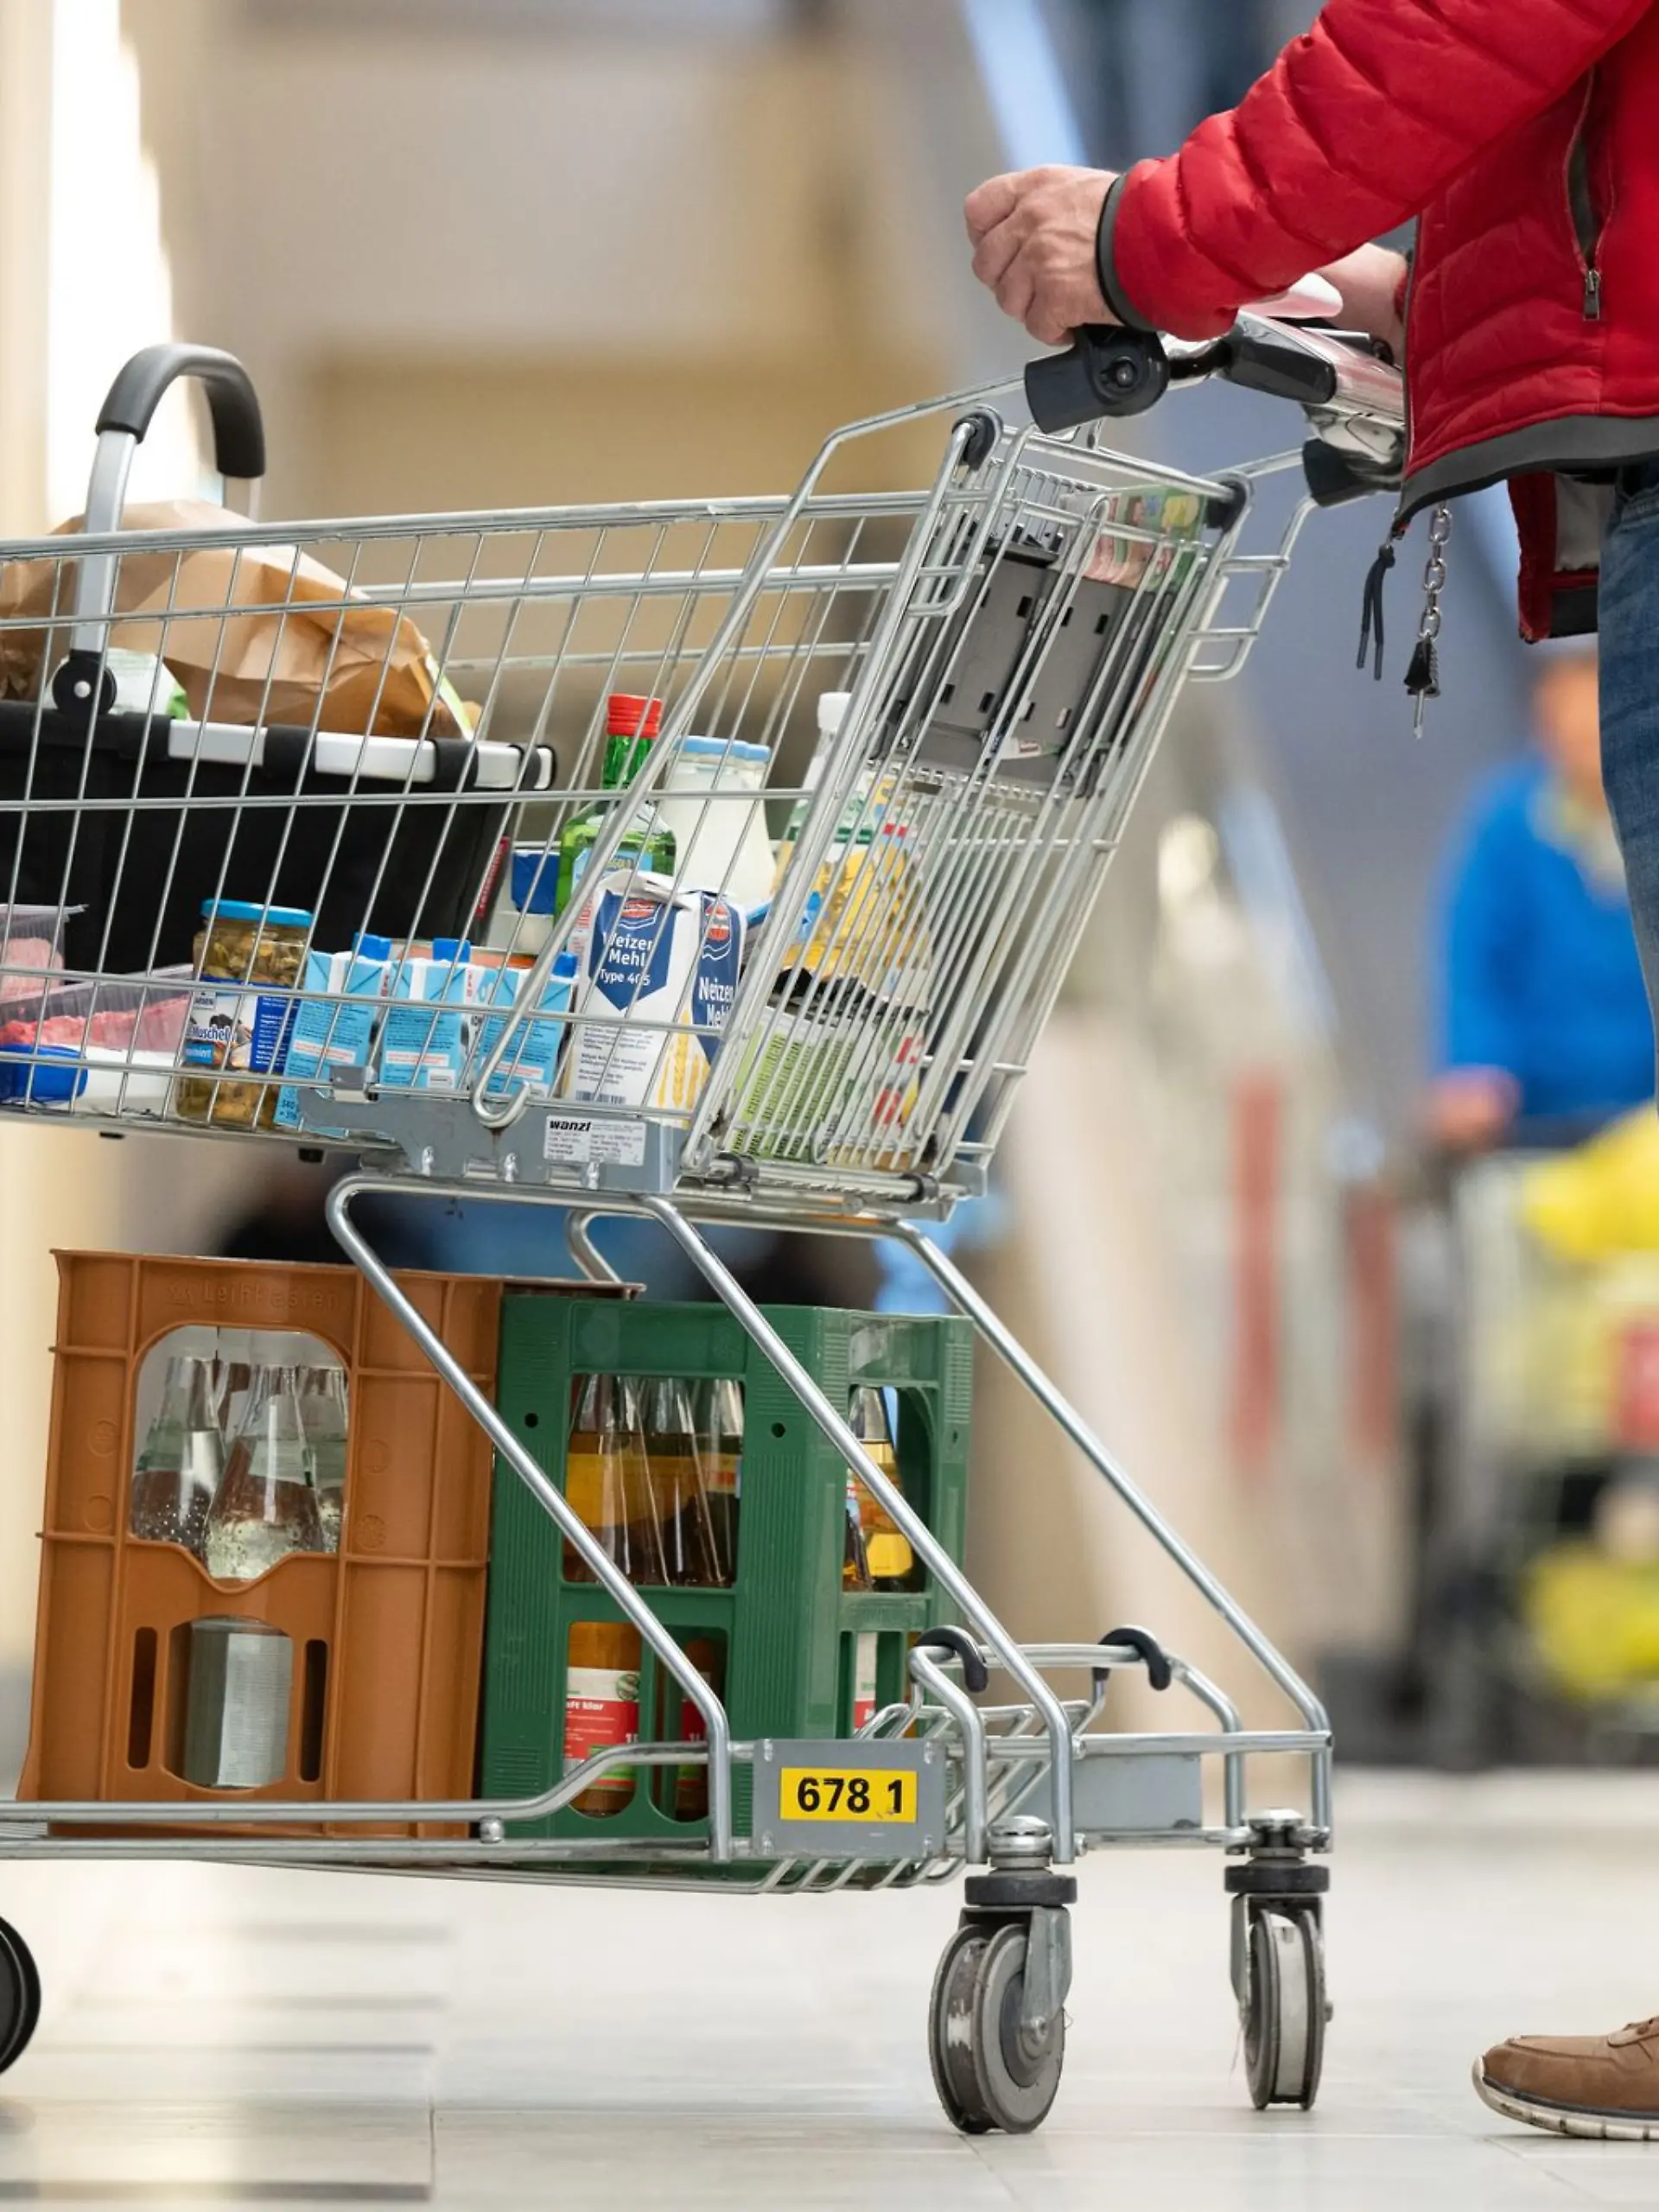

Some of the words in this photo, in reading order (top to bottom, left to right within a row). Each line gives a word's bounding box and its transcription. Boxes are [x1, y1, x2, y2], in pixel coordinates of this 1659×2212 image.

[608, 949, 647, 967] Mehl
[601, 969, 625, 984] Type
[550, 1121, 592, 1132] wanzl
[797, 1777, 870, 1814] 678
[887, 1778, 903, 1814] 1
